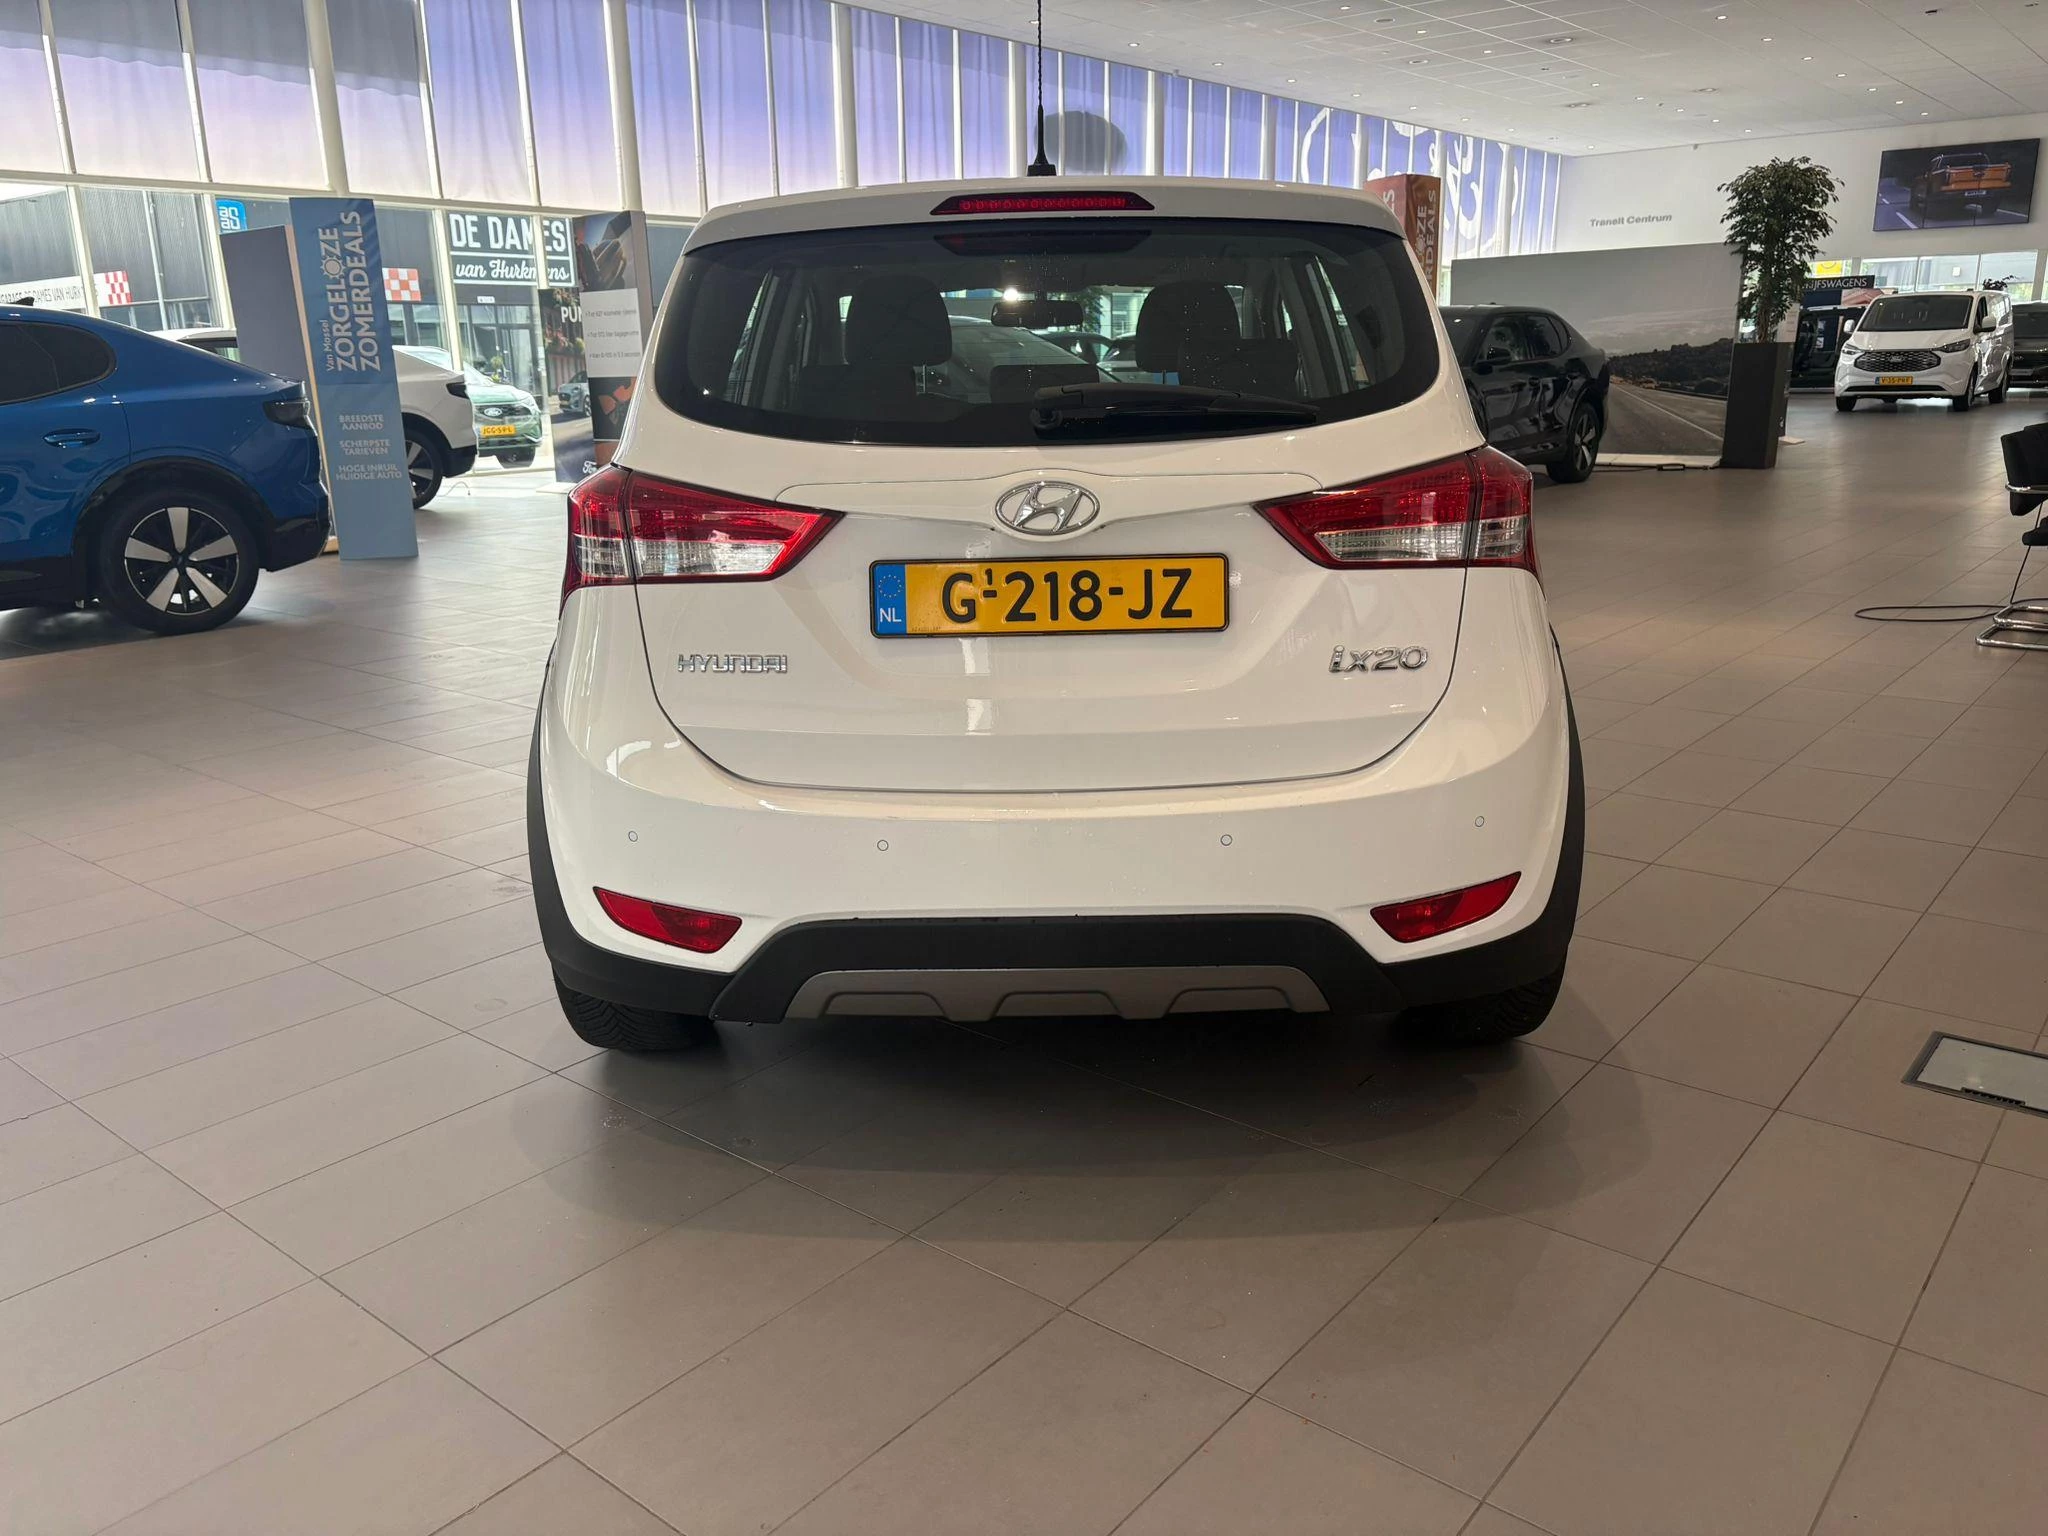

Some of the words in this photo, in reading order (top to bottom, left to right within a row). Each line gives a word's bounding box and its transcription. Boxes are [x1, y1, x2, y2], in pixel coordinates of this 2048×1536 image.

[1590, 216, 1625, 227] Transit
[1626, 214, 1673, 225] Centrum
[449, 213, 481, 248] DE
[1426, 189, 1436, 288] RDEALS
[455, 262, 487, 279] van
[340, 210, 381, 372] ZOMERDEALS
[319, 319, 333, 352] Mossel
[325, 353, 335, 372] Van
[339, 414, 384, 423] BREEDSTE
[342, 422, 383, 431] AANBOD
[339, 439, 391, 448] SCHERPSTE
[344, 447, 388, 456] TARIEVEN
[336, 472, 375, 481] HUIDIGE
[377, 470, 402, 479] AUTO
[338, 464, 366, 473] HOGE
[879, 608, 902, 623] NL
[677, 653, 788, 674] HYUNDAI
[1328, 644, 1428, 673] ix20
